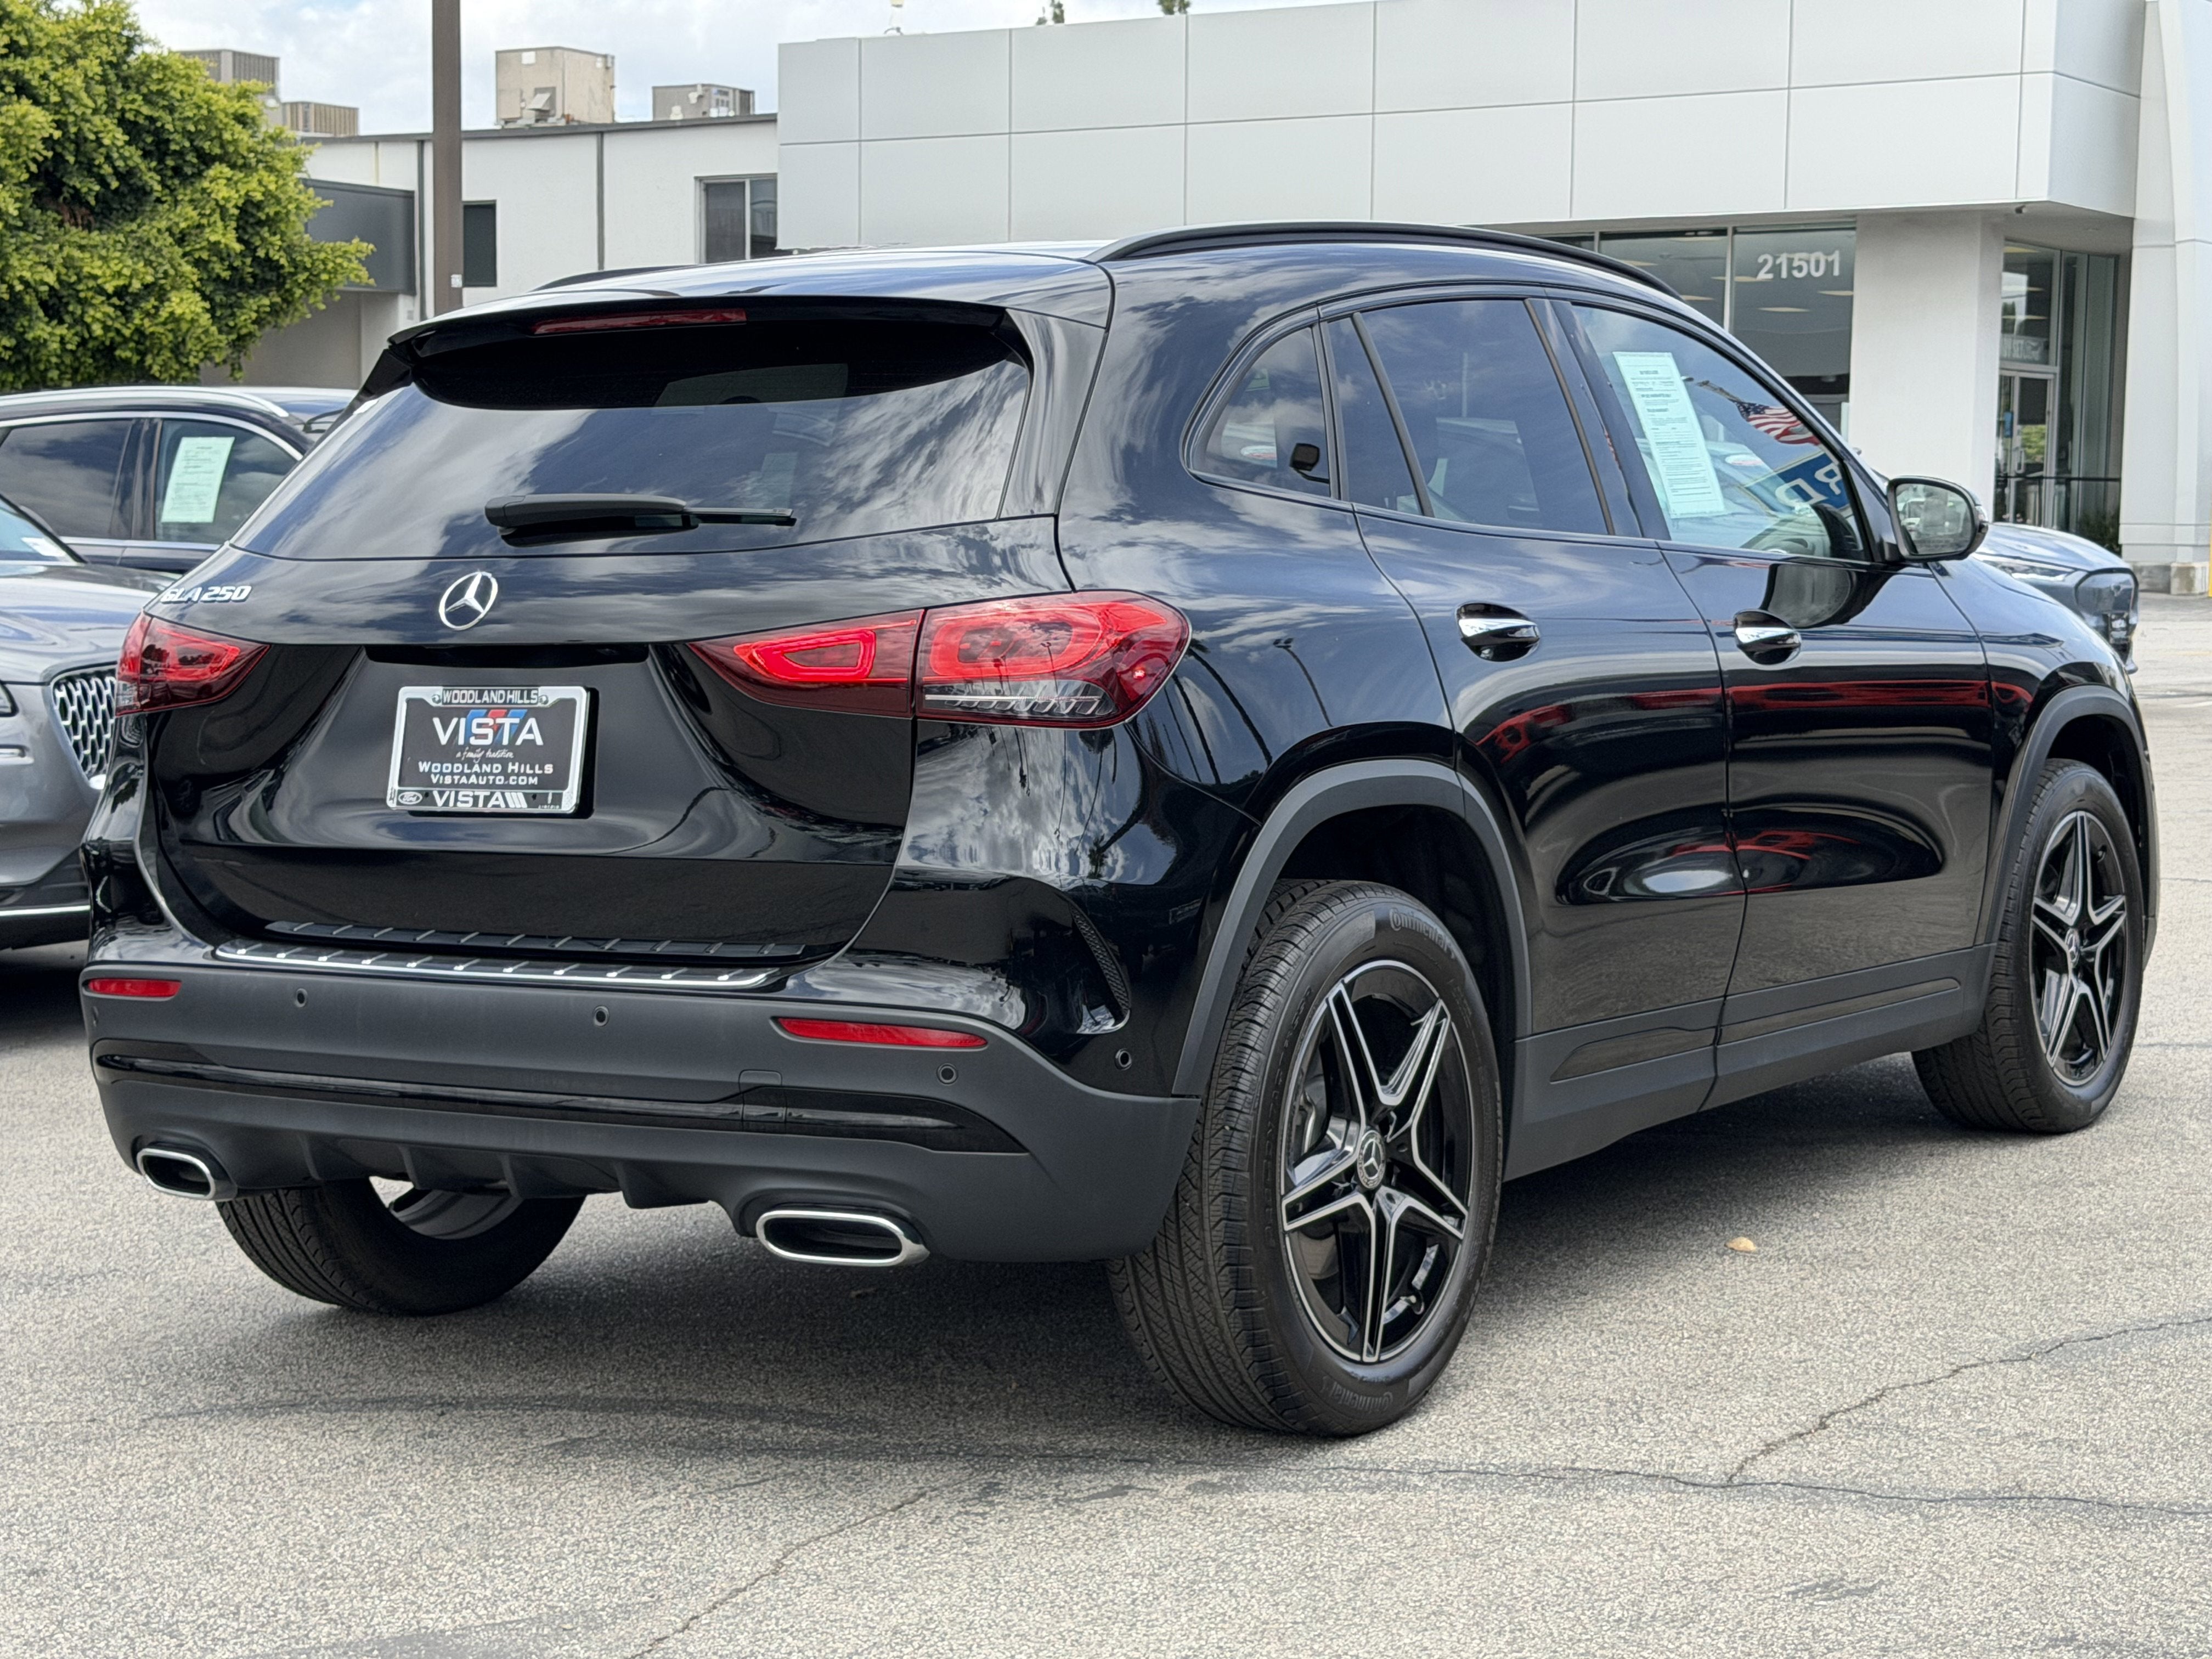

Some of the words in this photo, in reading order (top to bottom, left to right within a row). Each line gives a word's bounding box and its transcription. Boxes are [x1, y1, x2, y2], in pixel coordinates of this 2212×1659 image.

[1756, 250, 1839, 280] 21501
[161, 586, 202, 603] GLA
[201, 585, 252, 602] 250
[443, 690, 505, 703] WOODLAND
[506, 690, 539, 704] HILLS
[432, 717, 544, 746] VISTA
[433, 790, 506, 809] VISTA
[1389, 907, 1449, 953] Continental
